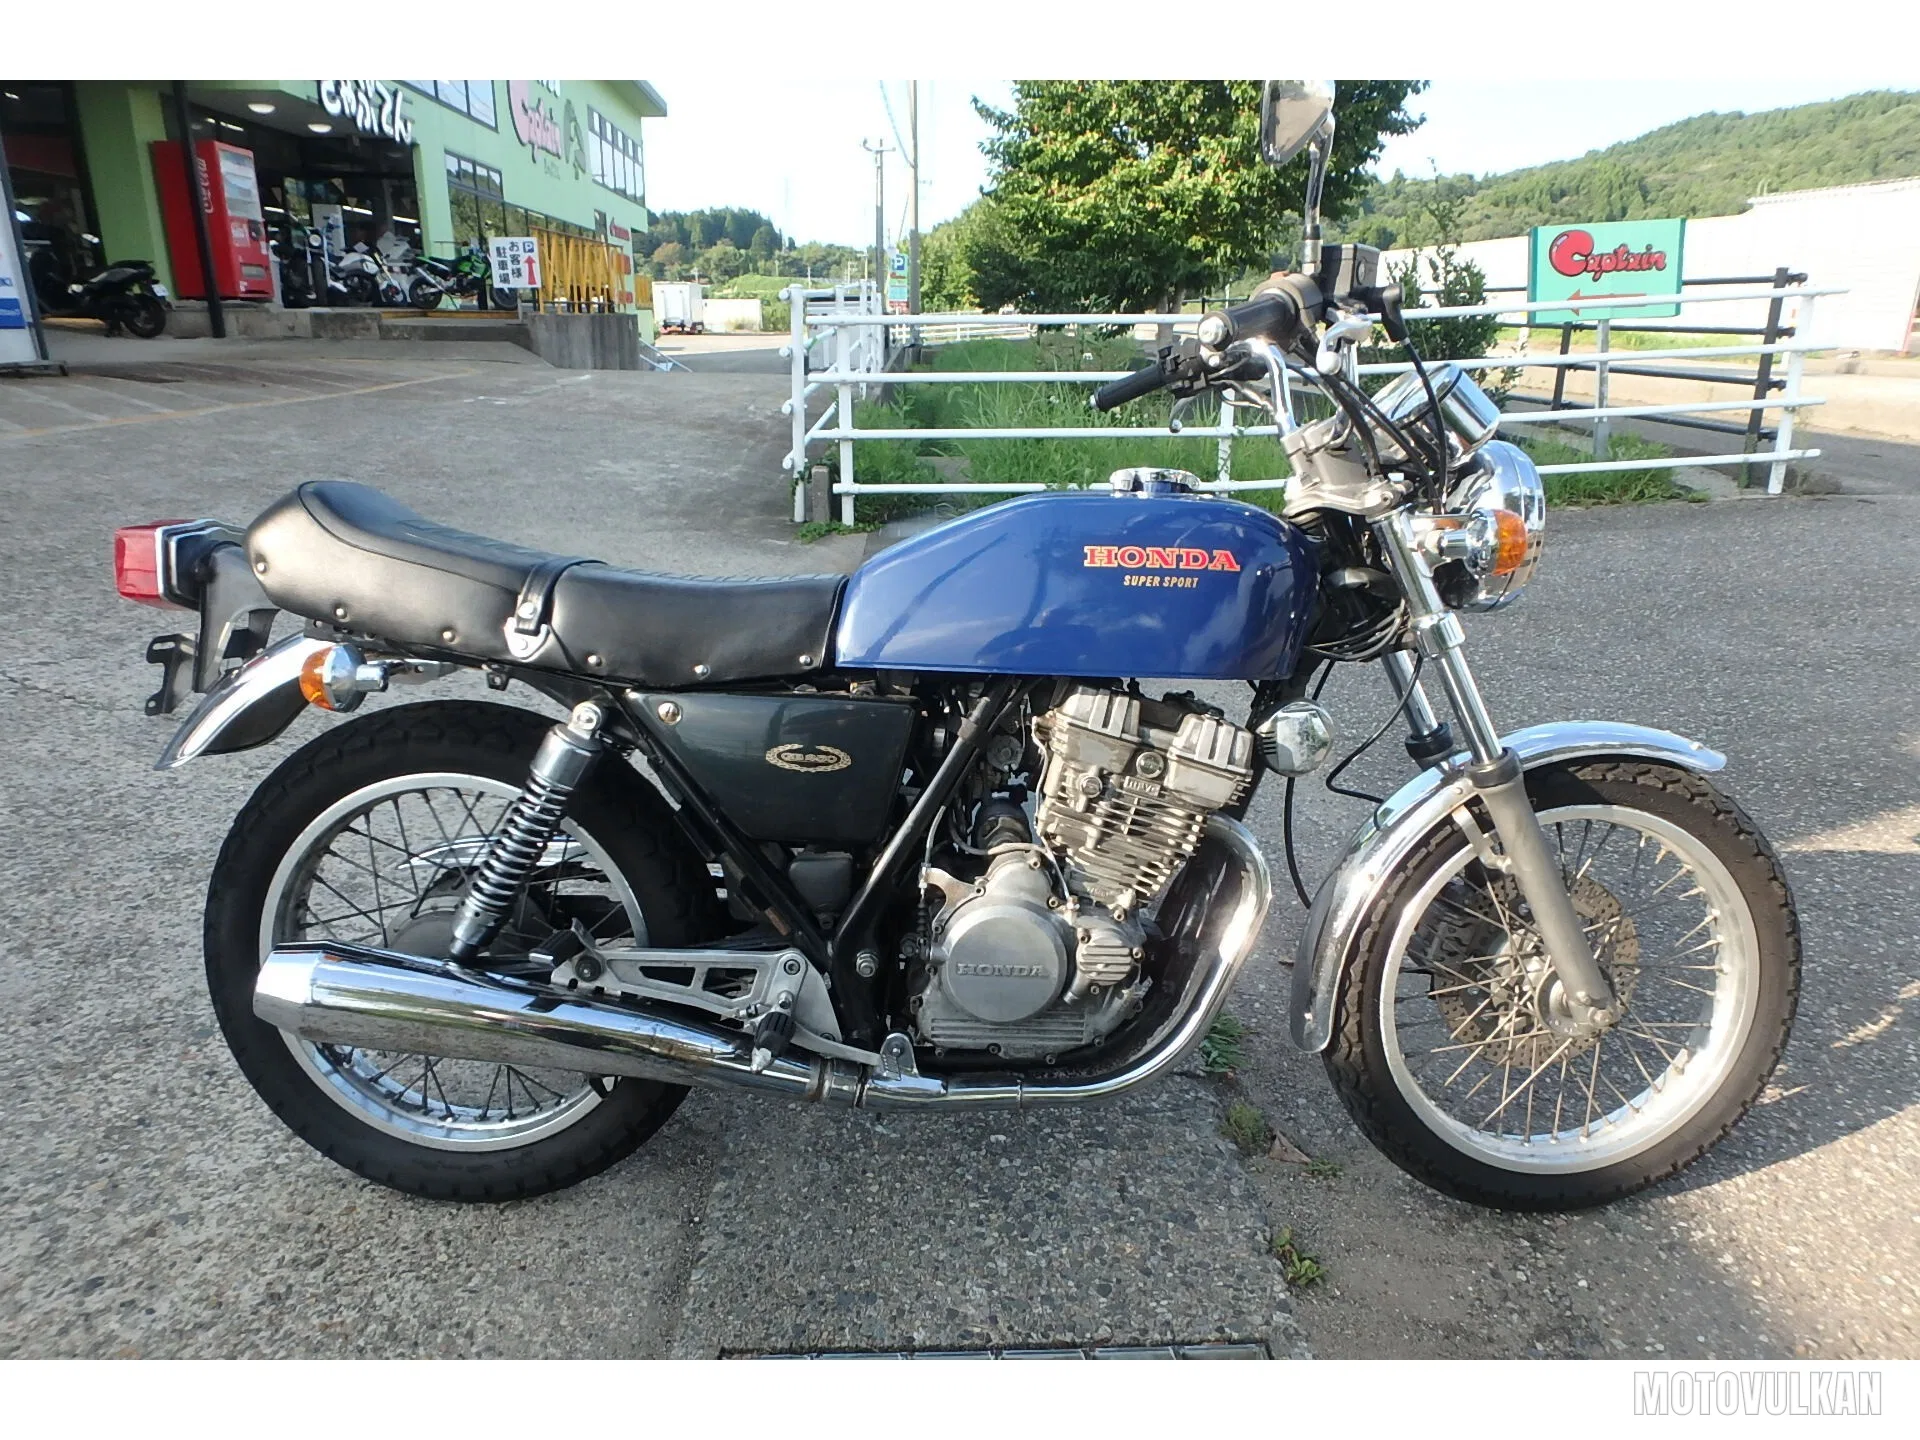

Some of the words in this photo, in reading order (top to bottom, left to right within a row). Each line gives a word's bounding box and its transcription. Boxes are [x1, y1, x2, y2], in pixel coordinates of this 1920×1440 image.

[496, 246, 510, 285] 駐車場
[509, 241, 522, 279] お客様
[1549, 229, 1667, 282] Captain
[1084, 545, 1241, 571] HONDA
[1124, 575, 1160, 587] SUPER
[1163, 576, 1199, 588] SPORT
[957, 962, 1049, 978] HONDA
